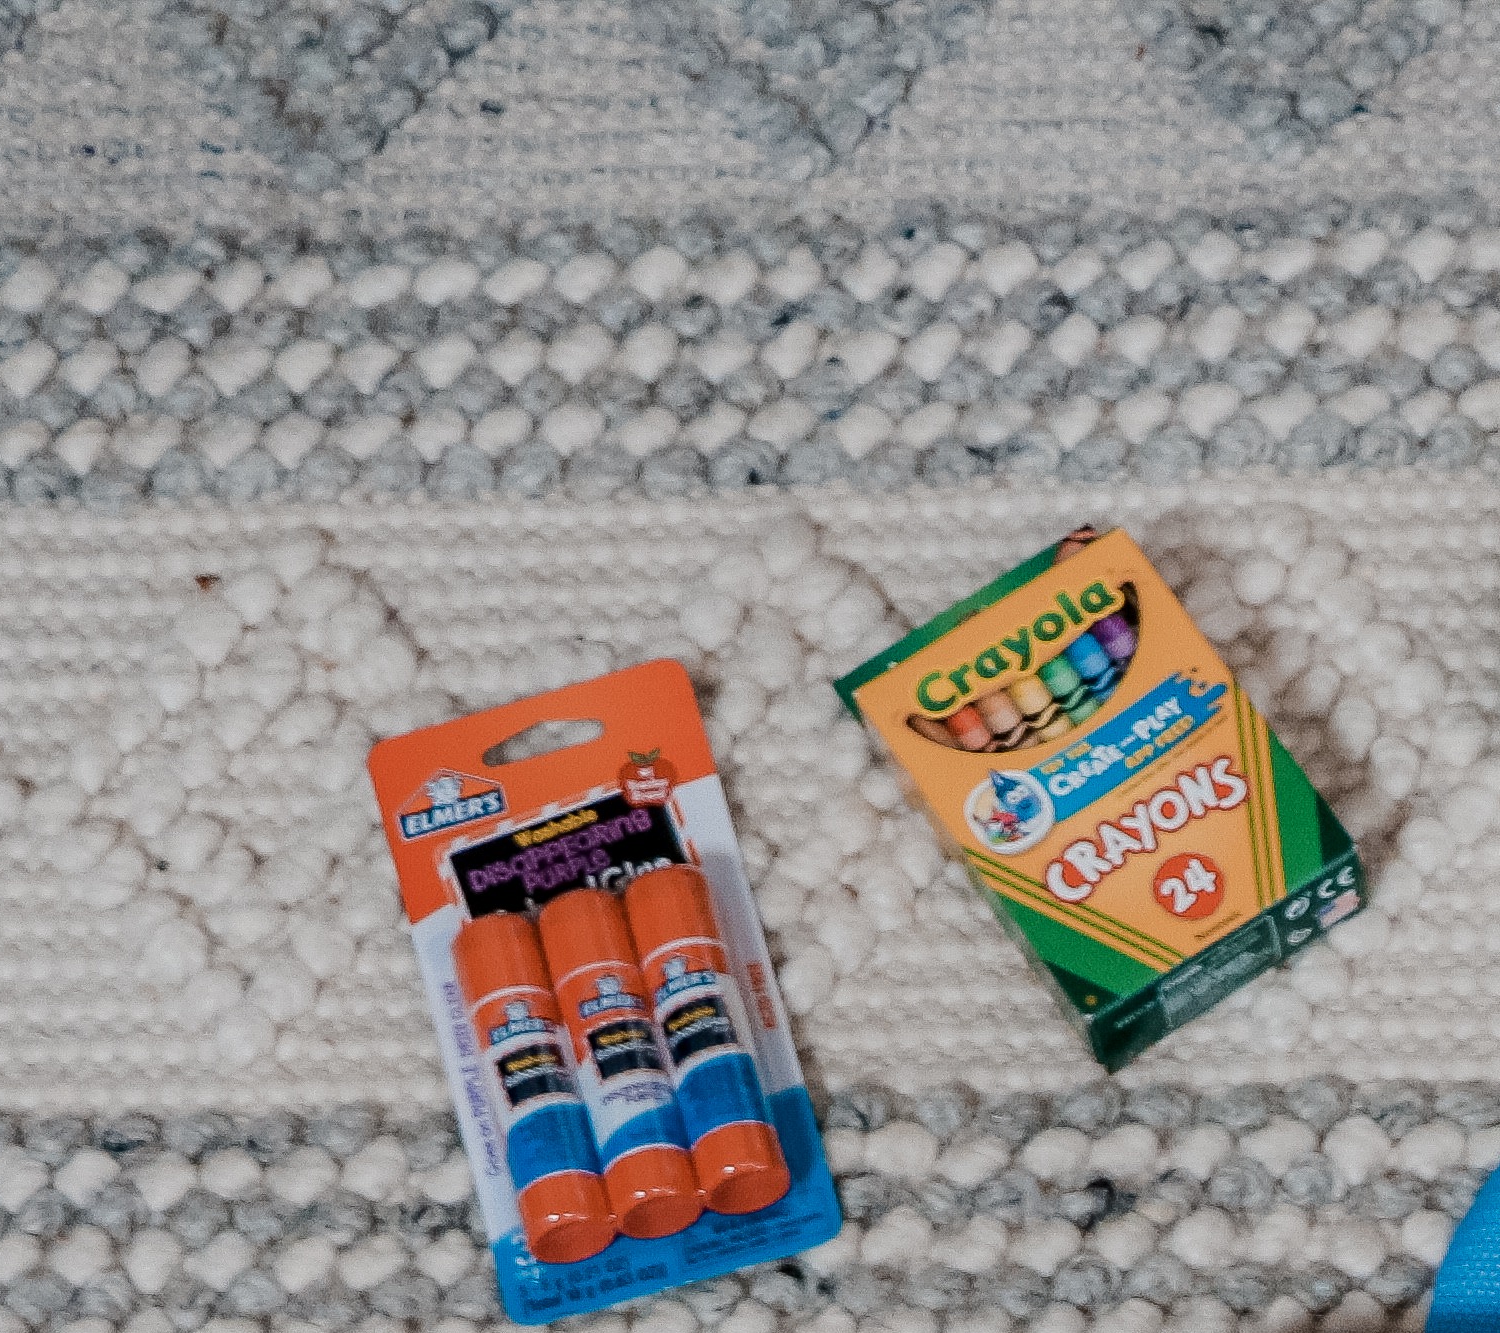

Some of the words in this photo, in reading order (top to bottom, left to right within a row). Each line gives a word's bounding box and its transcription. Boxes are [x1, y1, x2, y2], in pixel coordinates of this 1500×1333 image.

[916, 580, 1116, 712] Crayola
[1046, 756, 1248, 902] CRAYONS
[1160, 858, 1218, 915] 24
